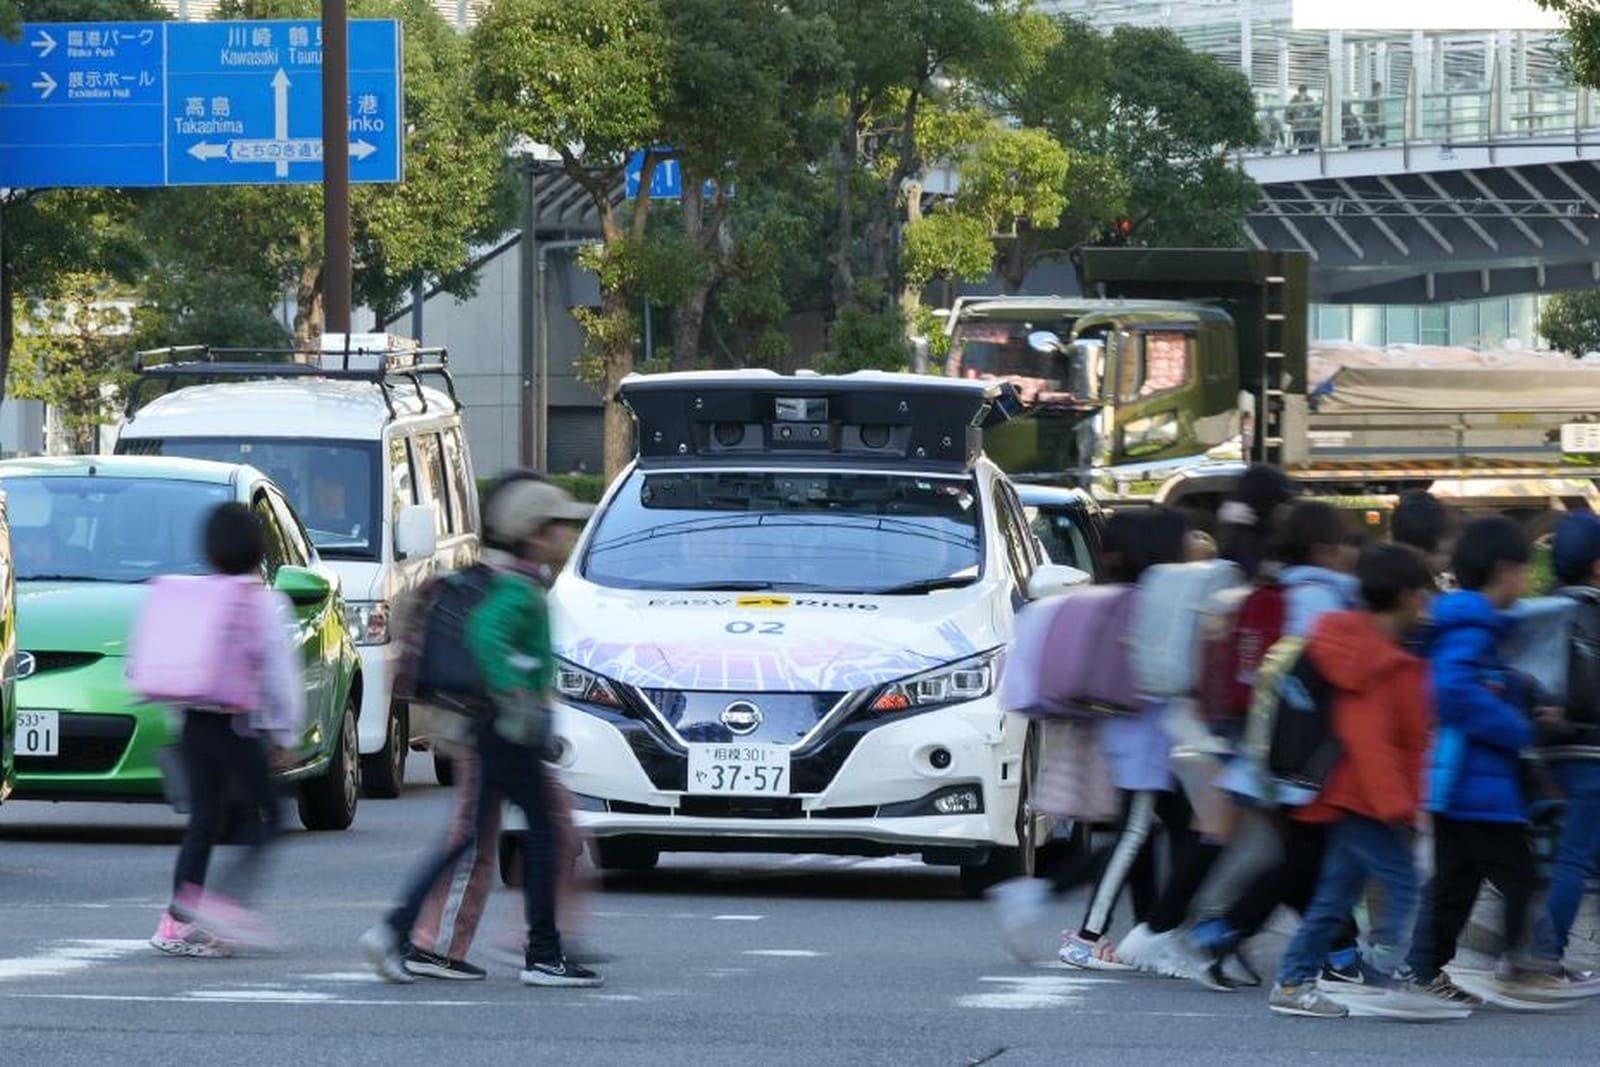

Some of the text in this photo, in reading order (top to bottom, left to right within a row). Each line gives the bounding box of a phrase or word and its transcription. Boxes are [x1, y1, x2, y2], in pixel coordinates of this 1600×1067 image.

[220, 48, 279, 66] Kawasaki
[186, 97, 230, 117] 高島
[174, 117, 244, 134] Takashima
[347, 115, 385, 132] inko
[795, 598, 879, 611] Ride
[724, 620, 786, 635] 02
[26, 729, 51, 752] 01
[711, 765, 784, 791] 37-57
